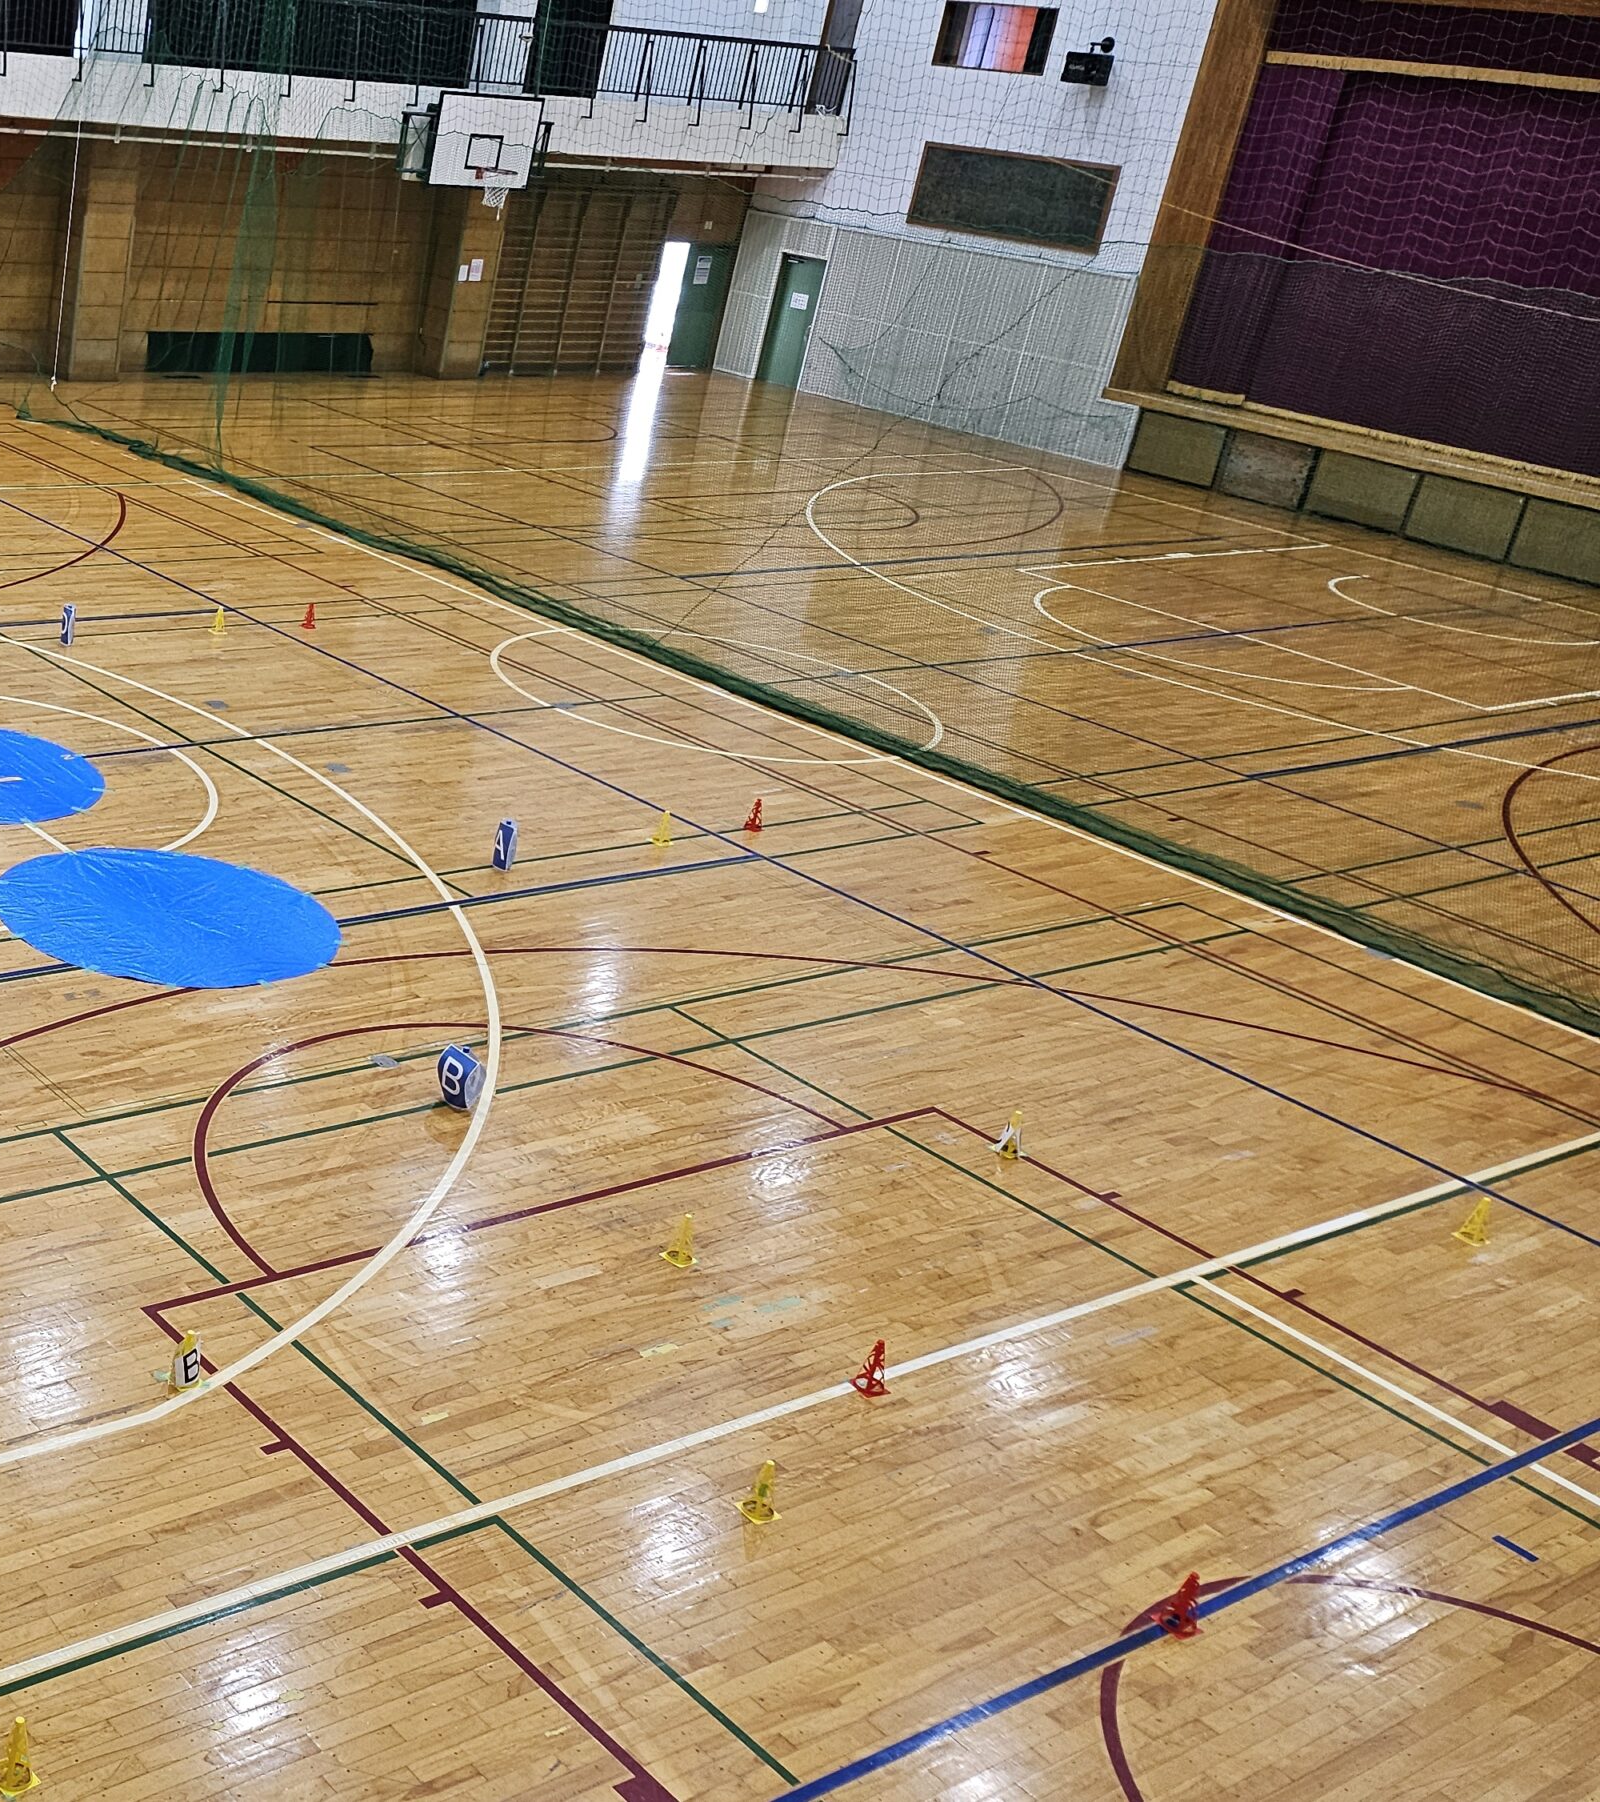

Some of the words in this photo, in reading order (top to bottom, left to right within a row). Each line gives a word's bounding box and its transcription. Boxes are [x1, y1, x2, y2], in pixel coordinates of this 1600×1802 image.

[494, 829, 505, 861] A
[441, 1055, 464, 1096] B
[182, 1347, 200, 1384] B
